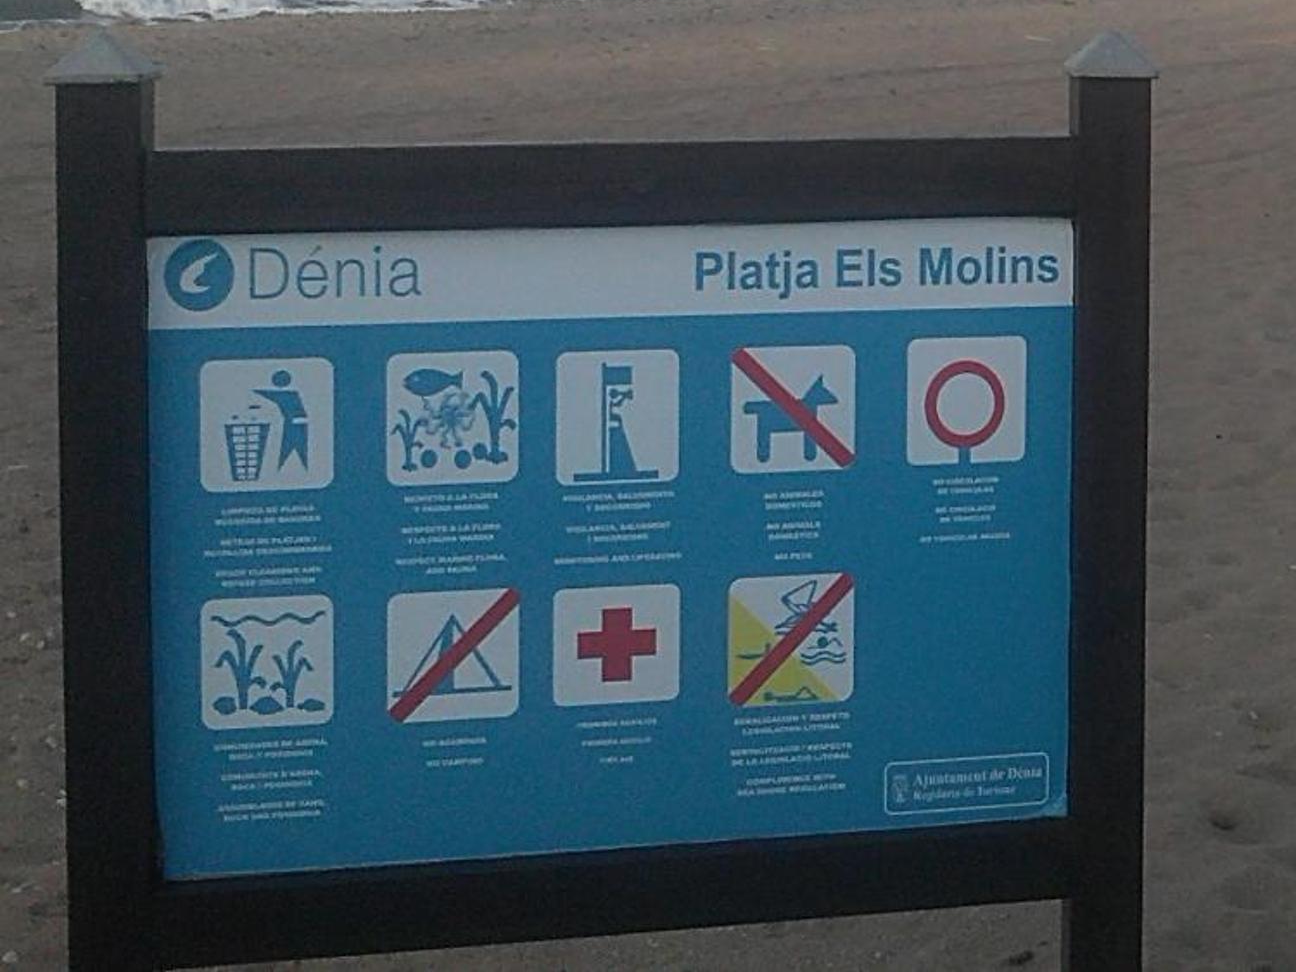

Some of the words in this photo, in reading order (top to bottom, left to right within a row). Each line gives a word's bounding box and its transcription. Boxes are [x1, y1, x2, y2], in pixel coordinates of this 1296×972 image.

[249, 245, 422, 300] Dénia
[695, 250, 820, 299] Platja
[836, 248, 902, 288] Els
[918, 246, 1060, 286] Molins
[912, 772, 987, 790] Ajuntament
